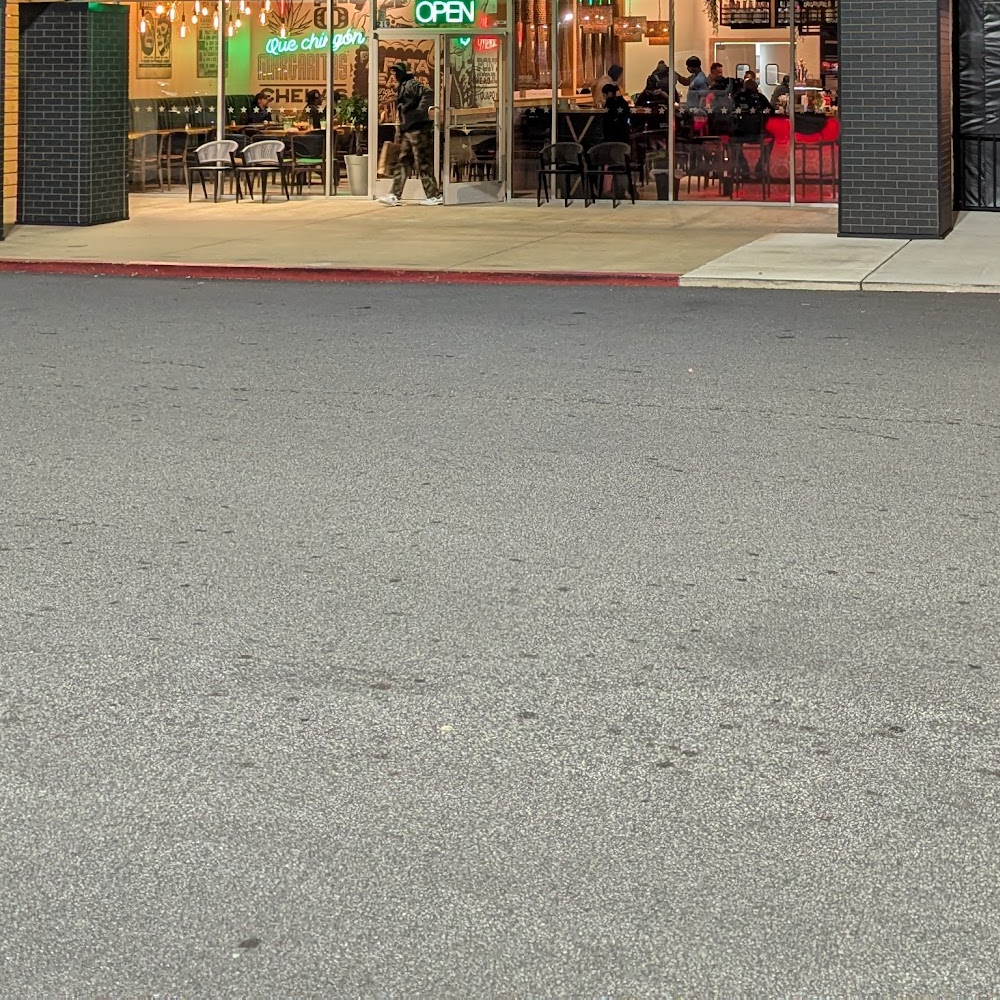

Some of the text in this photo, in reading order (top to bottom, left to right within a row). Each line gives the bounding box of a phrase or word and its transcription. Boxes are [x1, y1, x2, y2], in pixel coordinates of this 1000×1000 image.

[415, 0, 475, 24] OPEN
[265, 28, 366, 55] Que chigón
